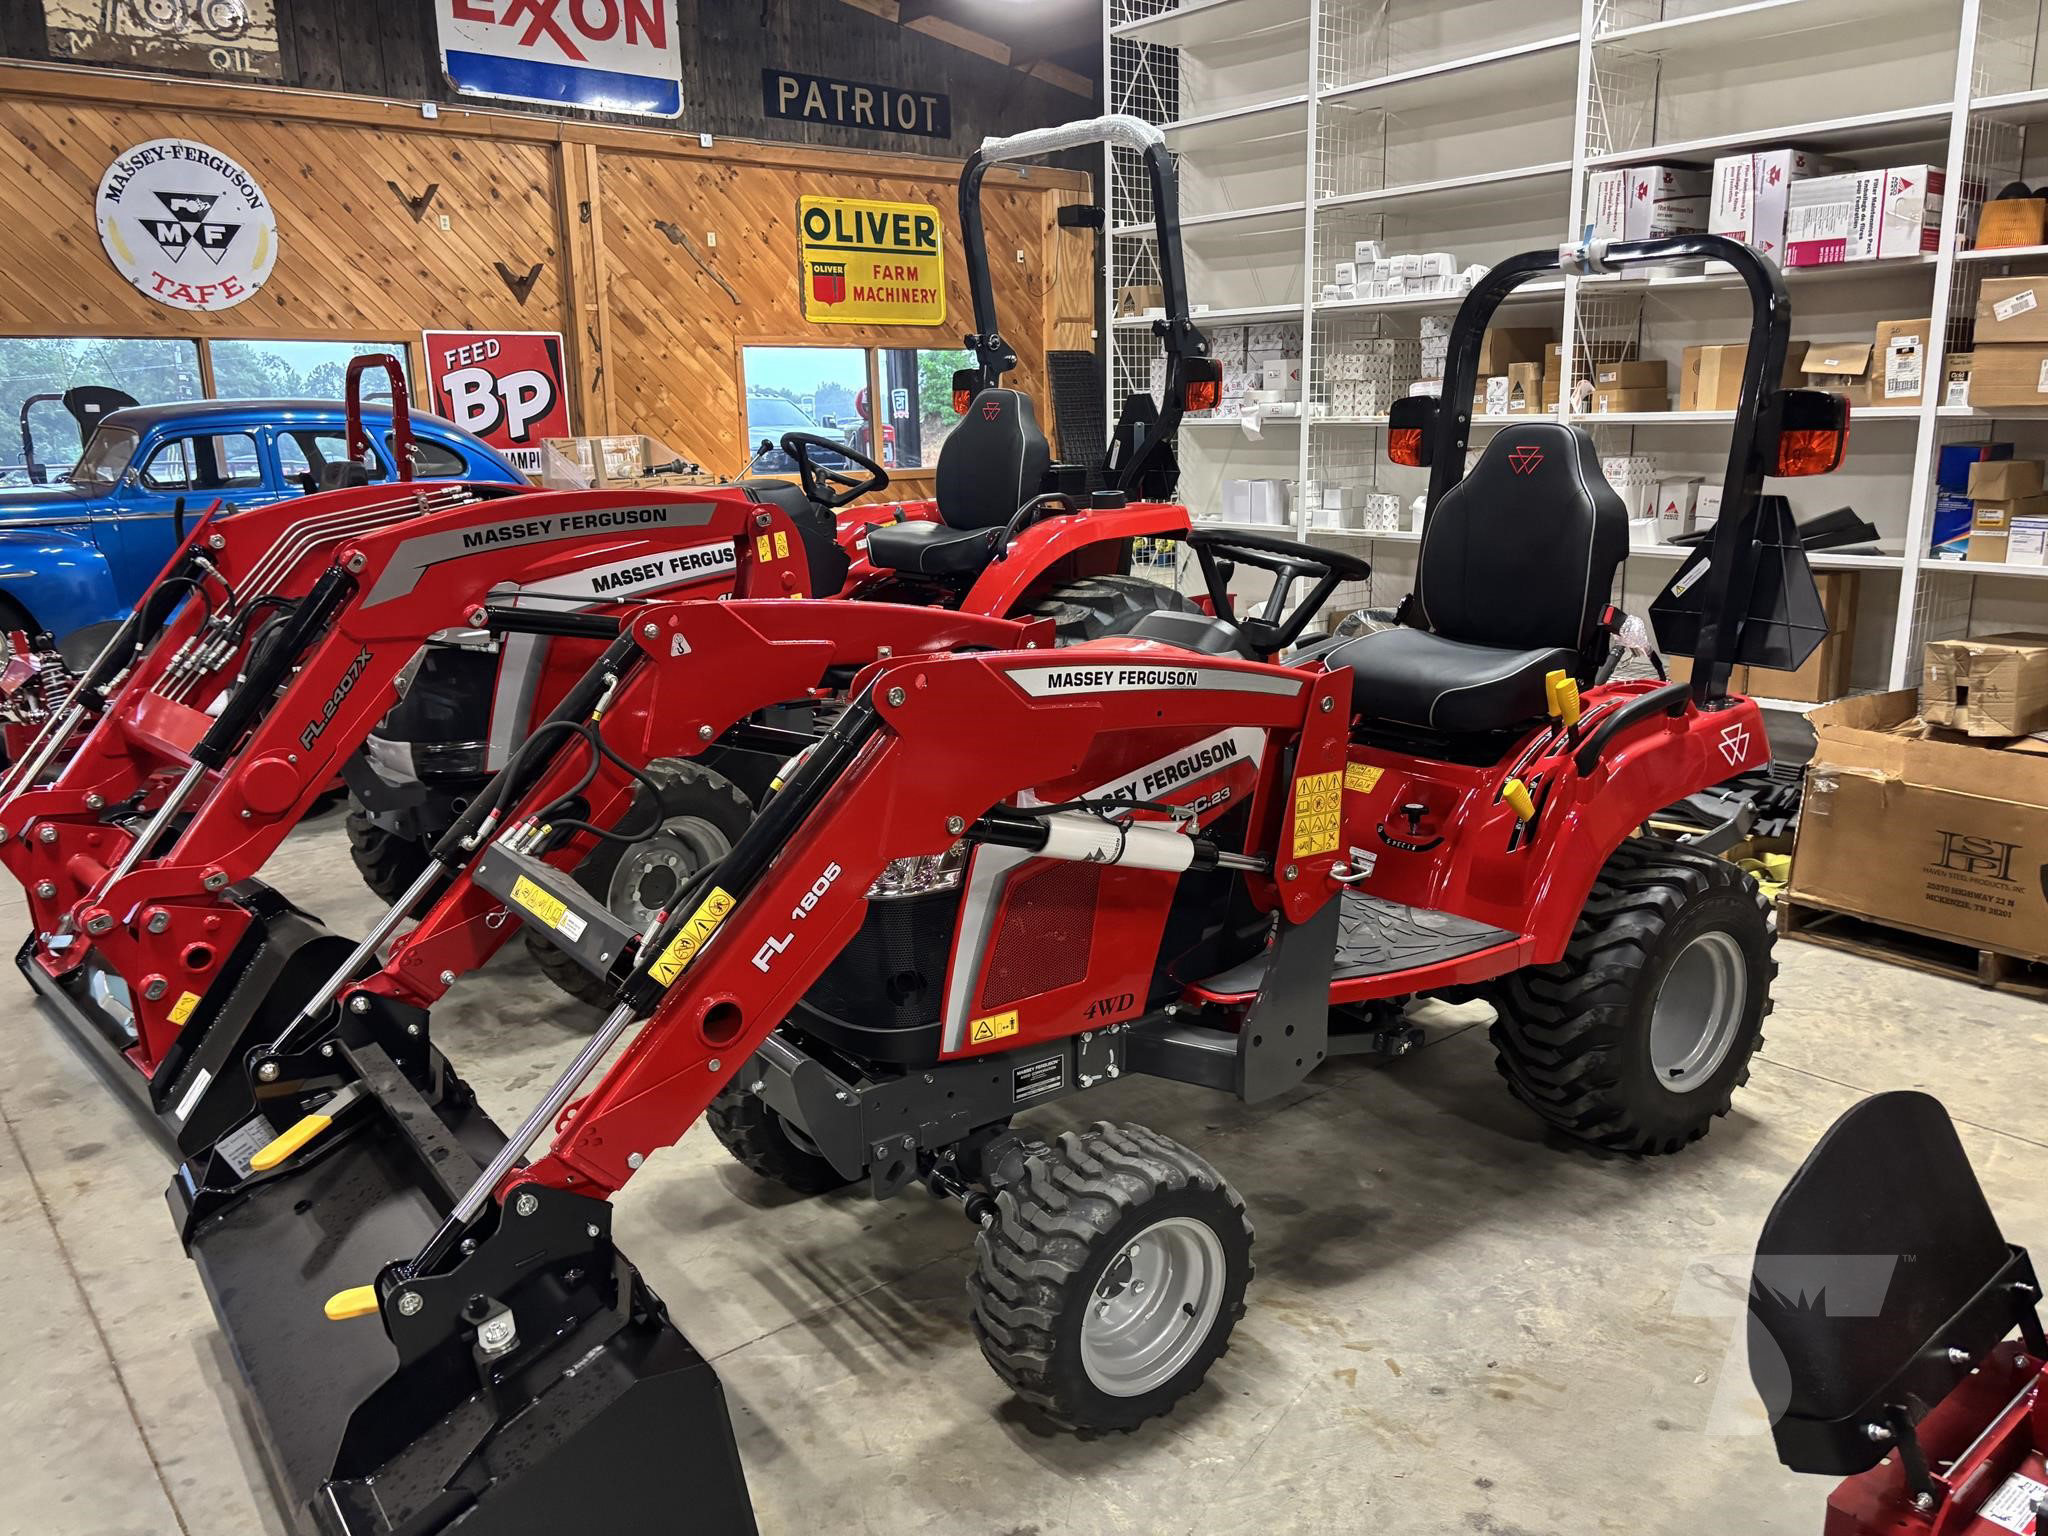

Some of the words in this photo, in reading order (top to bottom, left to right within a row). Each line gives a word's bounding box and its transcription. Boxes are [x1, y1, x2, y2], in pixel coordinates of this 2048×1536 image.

[208, 48, 260, 73] OIL
[778, 76, 937, 132] PATRIOT
[105, 145, 264, 210] MASSEY-FERGUSON
[803, 207, 937, 247] OLIVER
[813, 264, 844, 274] OLIVER
[873, 264, 919, 281] FARM
[152, 271, 245, 304] TAFE
[853, 286, 937, 304] MACHINERY
[444, 339, 500, 371] FEED
[441, 366, 556, 442] BP
[463, 519, 552, 548] MASSEY
[560, 508, 667, 532] FERGUSON
[592, 560, 664, 593] MASSEY
[669, 547, 736, 573] FERGUS
[1048, 671, 1114, 688] MASSEY
[1118, 670, 1198, 686] FERGUSON
[300, 644, 373, 752] FL.2407X
[1142, 738, 1238, 795] FERGUSON
[1951, 887, 1995, 903] HIGHWAY
[751, 932, 796, 973] FL
[791, 861, 842, 920] 1805
[1083, 993, 1135, 1020] 4WD
